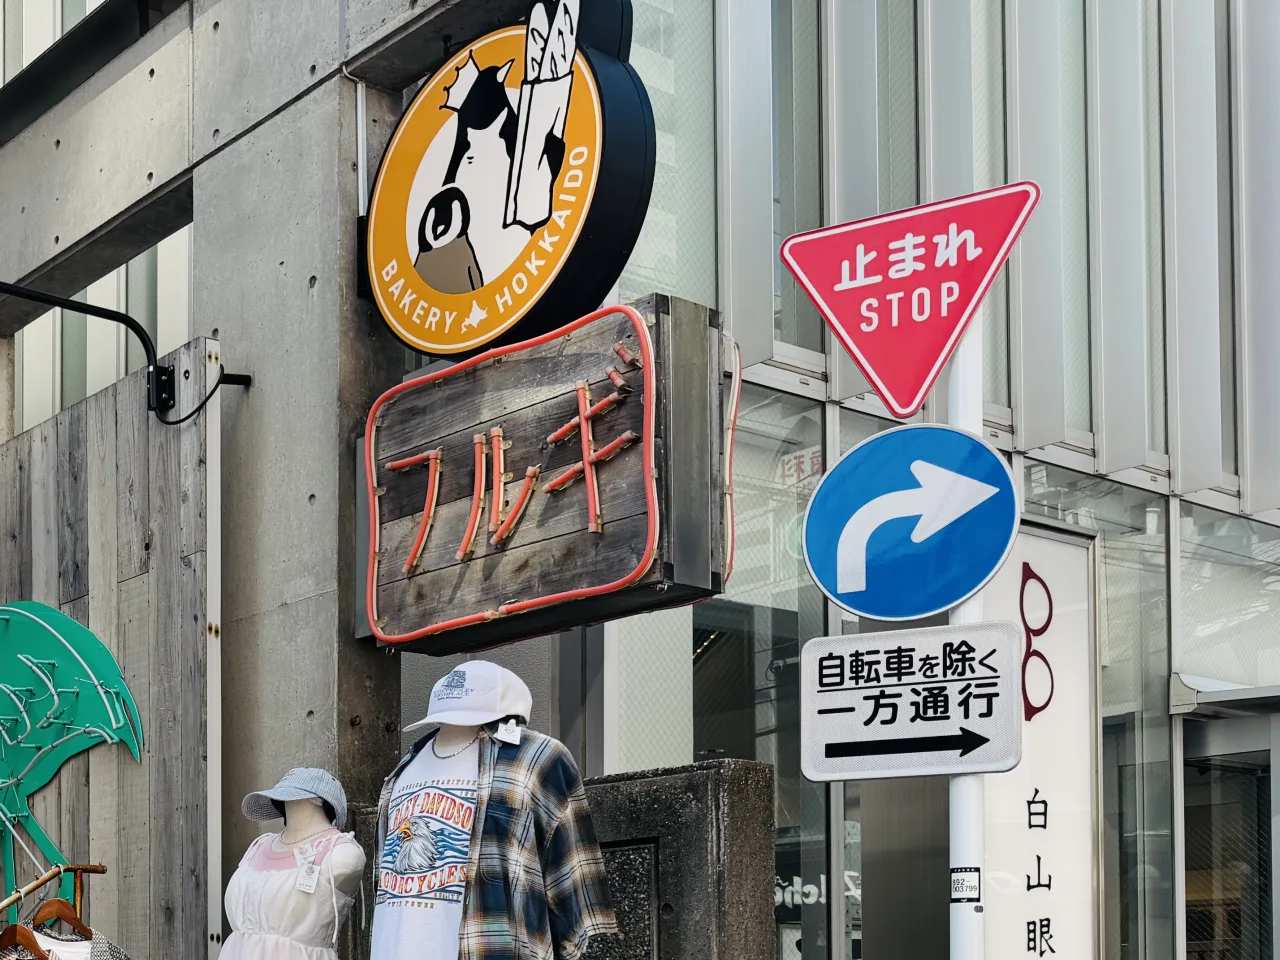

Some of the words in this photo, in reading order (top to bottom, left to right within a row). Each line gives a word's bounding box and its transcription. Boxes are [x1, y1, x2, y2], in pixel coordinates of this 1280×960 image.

[381, 258, 458, 334] BAKERY
[494, 145, 589, 314] HOKKAIDO
[833, 222, 983, 292] 止まれ
[859, 281, 960, 333] STOP
[384, 341, 642, 574] フルギ
[818, 639, 999, 688] 自転車を除く
[816, 681, 1000, 727] 一方通行
